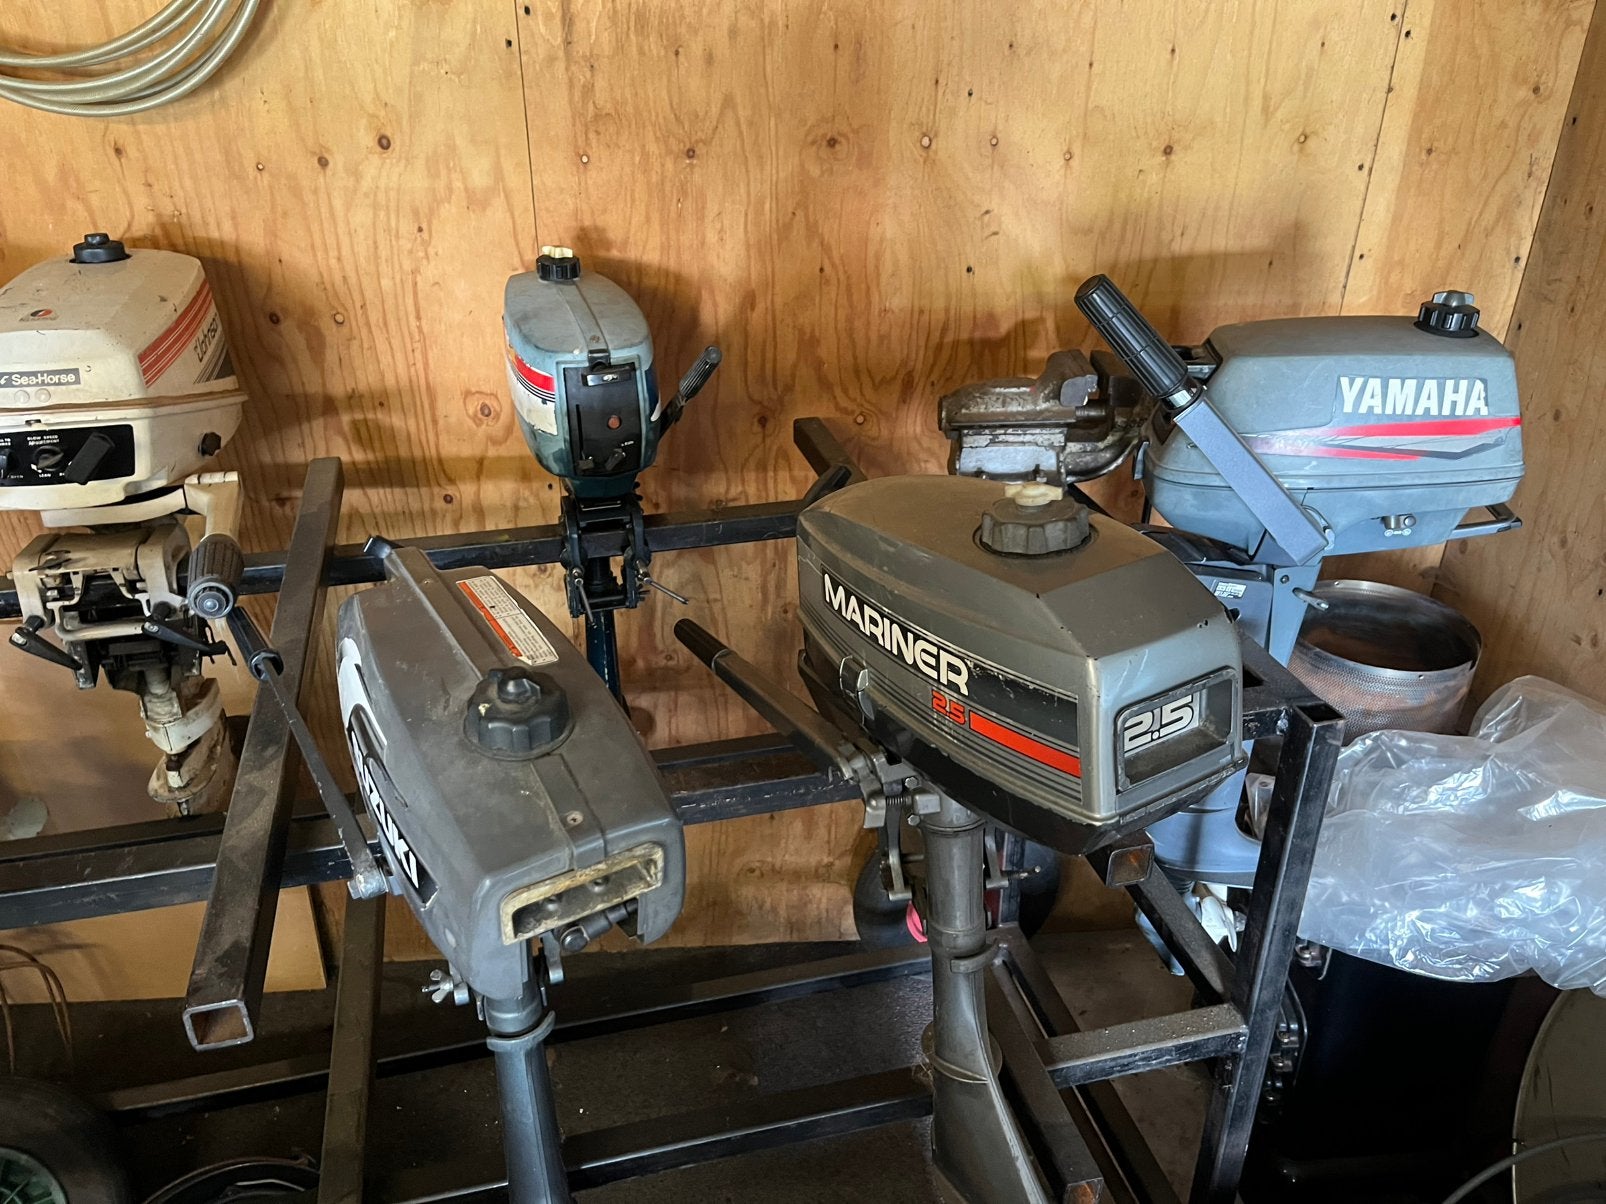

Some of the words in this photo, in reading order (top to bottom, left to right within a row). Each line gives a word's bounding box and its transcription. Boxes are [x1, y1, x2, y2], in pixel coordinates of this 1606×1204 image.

[11, 373, 76, 385] Sea-Horse
[1340, 376, 1488, 416] YAMAHA
[824, 573, 969, 696] MARINER
[931, 689, 966, 726] 2.5
[1123, 694, 1194, 753] 2.5
